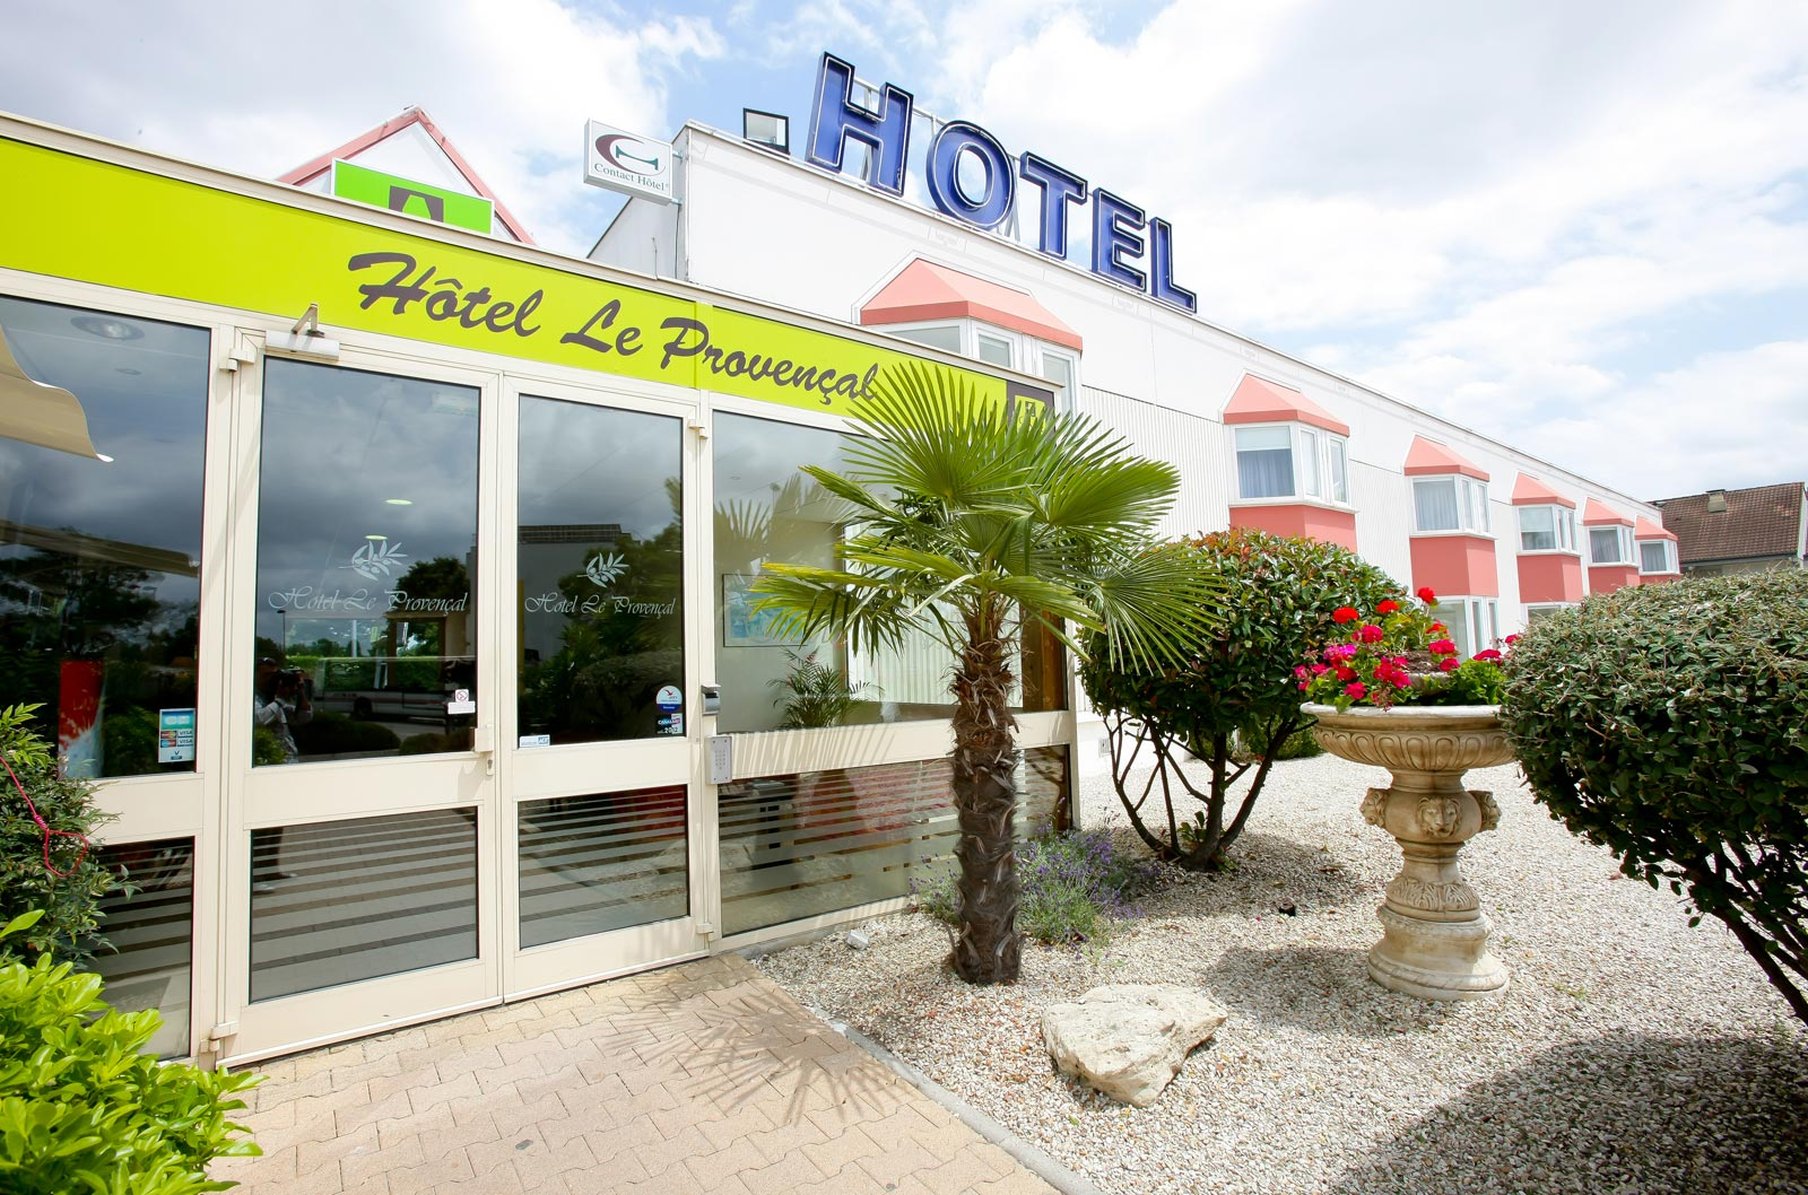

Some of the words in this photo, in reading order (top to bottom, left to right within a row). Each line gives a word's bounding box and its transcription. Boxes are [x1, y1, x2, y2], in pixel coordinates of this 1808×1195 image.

[594, 162, 634, 182] Contact
[805, 51, 1197, 314] HOTEL
[348, 252, 543, 337] Hôtel
[560, 299, 643, 356] Le
[660, 317, 878, 405] Provençal
[344, 588, 376, 611] Le
[384, 589, 468, 617] Provençal
[581, 594, 607, 614] Le
[611, 594, 677, 619] Provençal
